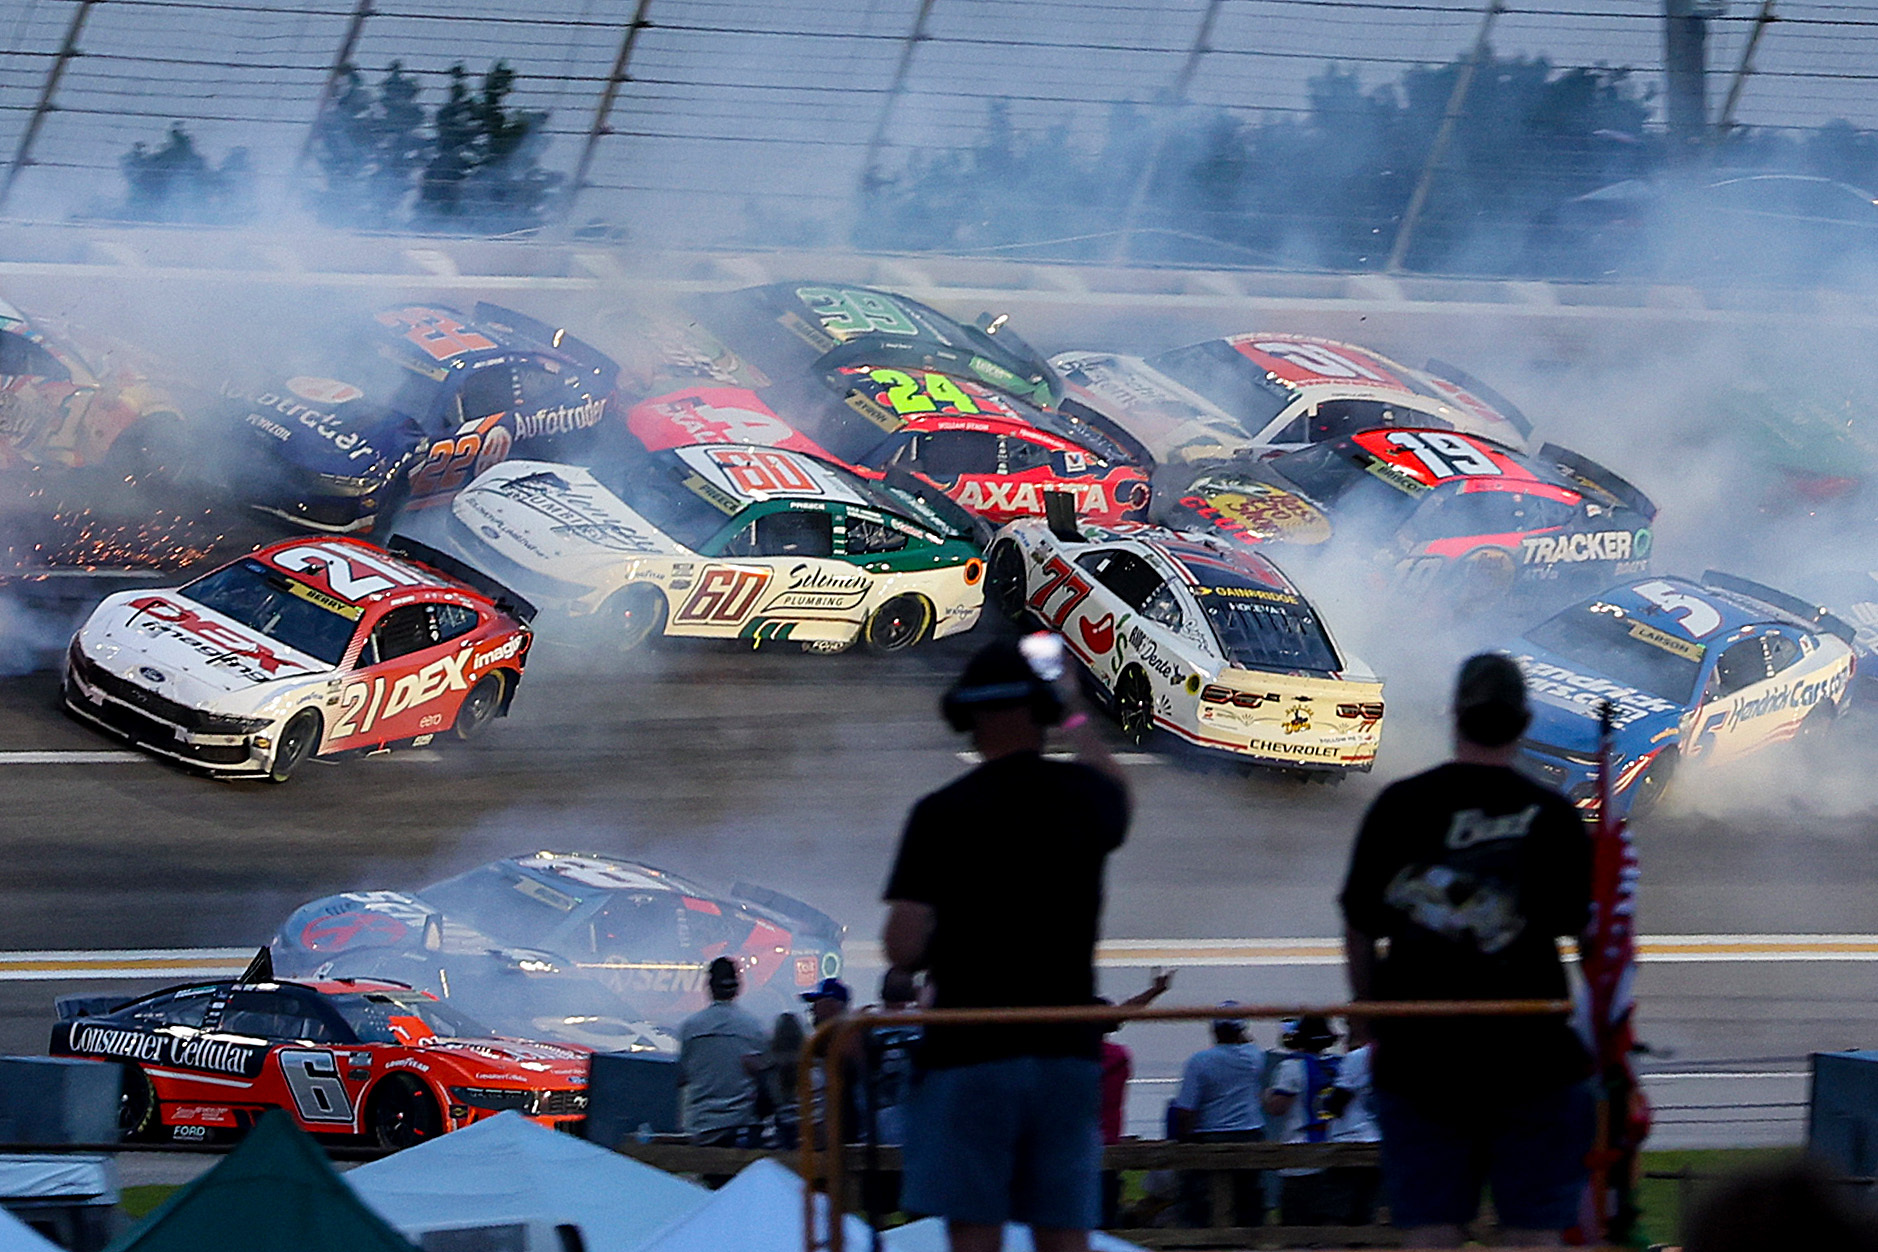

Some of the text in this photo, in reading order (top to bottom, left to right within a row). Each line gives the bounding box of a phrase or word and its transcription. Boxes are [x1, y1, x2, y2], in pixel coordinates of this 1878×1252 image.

[869, 369, 967, 414] 24
[408, 434, 482, 497] 22
[712, 450, 817, 493] 60
[1386, 432, 1503, 478] 19
[956, 481, 1109, 515] AXATA
[1521, 530, 1634, 565] TRACKER
[272, 542, 420, 601] 21
[1028, 554, 1096, 630] 77
[675, 569, 770, 622] 60
[783, 595, 844, 607] PLUMBING
[1215, 586, 1299, 605] GAINBRIDGE
[1632, 580, 1723, 639] 5
[381, 647, 475, 720] DEX
[328, 676, 386, 741] 21
[1249, 738, 1342, 758] CHEVROLET
[69, 1021, 254, 1075] Consumer Cellular
[385, 1056, 431, 1074] GOODYEAR
[279, 1047, 356, 1124] 6
[173, 1125, 206, 1137] FORD
